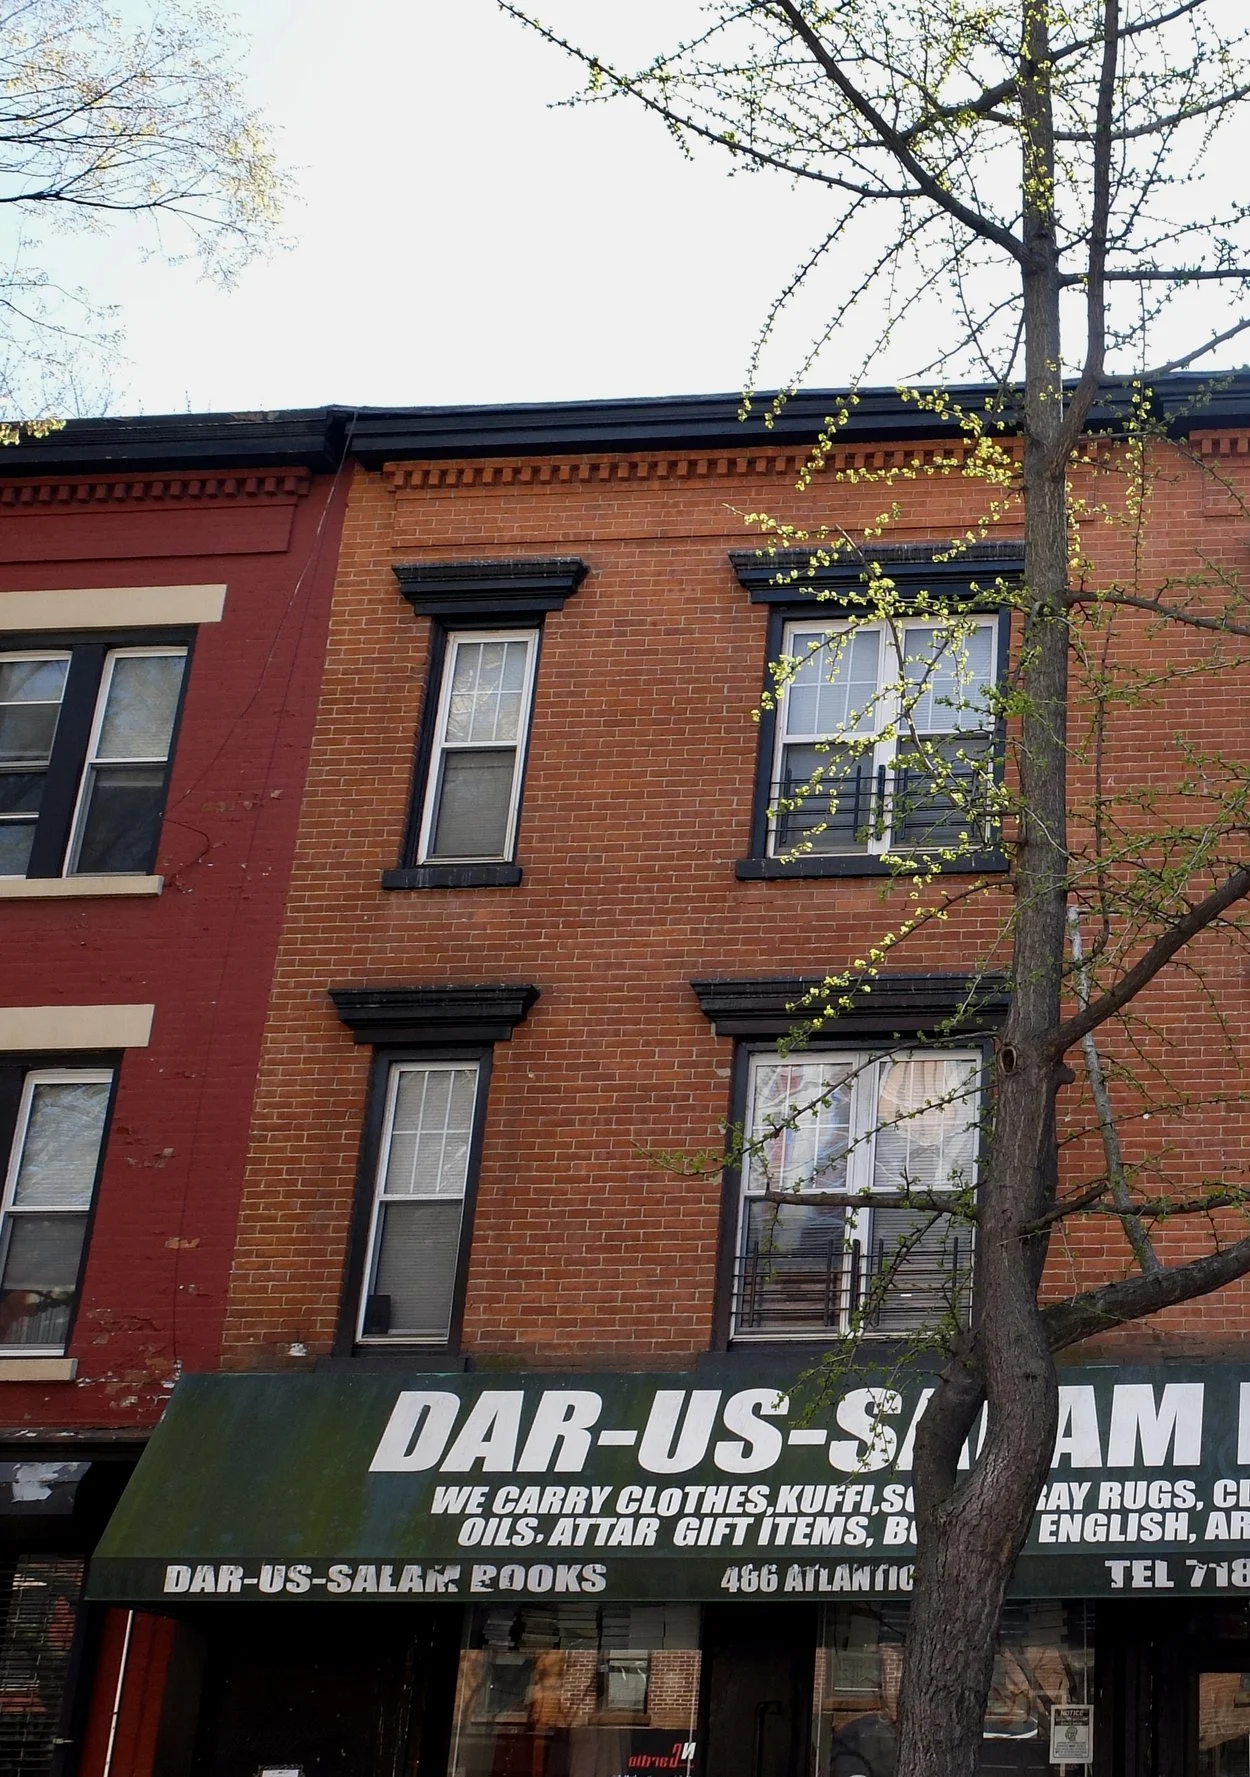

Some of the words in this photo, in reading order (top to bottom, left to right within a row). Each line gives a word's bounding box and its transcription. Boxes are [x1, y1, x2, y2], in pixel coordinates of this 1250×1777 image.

[369, 1383, 1204, 1474] DAR-US-SAM
[431, 1486, 482, 1515] WE
[492, 1485, 613, 1514] CARRY
[1098, 1480, 1204, 1513] RUGS,
[549, 1517, 657, 1547] ATTAR
[673, 1517, 748, 1546] GIFT
[757, 1516, 875, 1549] ITEMS,
[1038, 1512, 1197, 1544] ENGLISH,
[470, 1564, 607, 1593] BOOKS
[720, 1563, 778, 1593] 486
[1105, 1559, 1175, 1588] TEL
